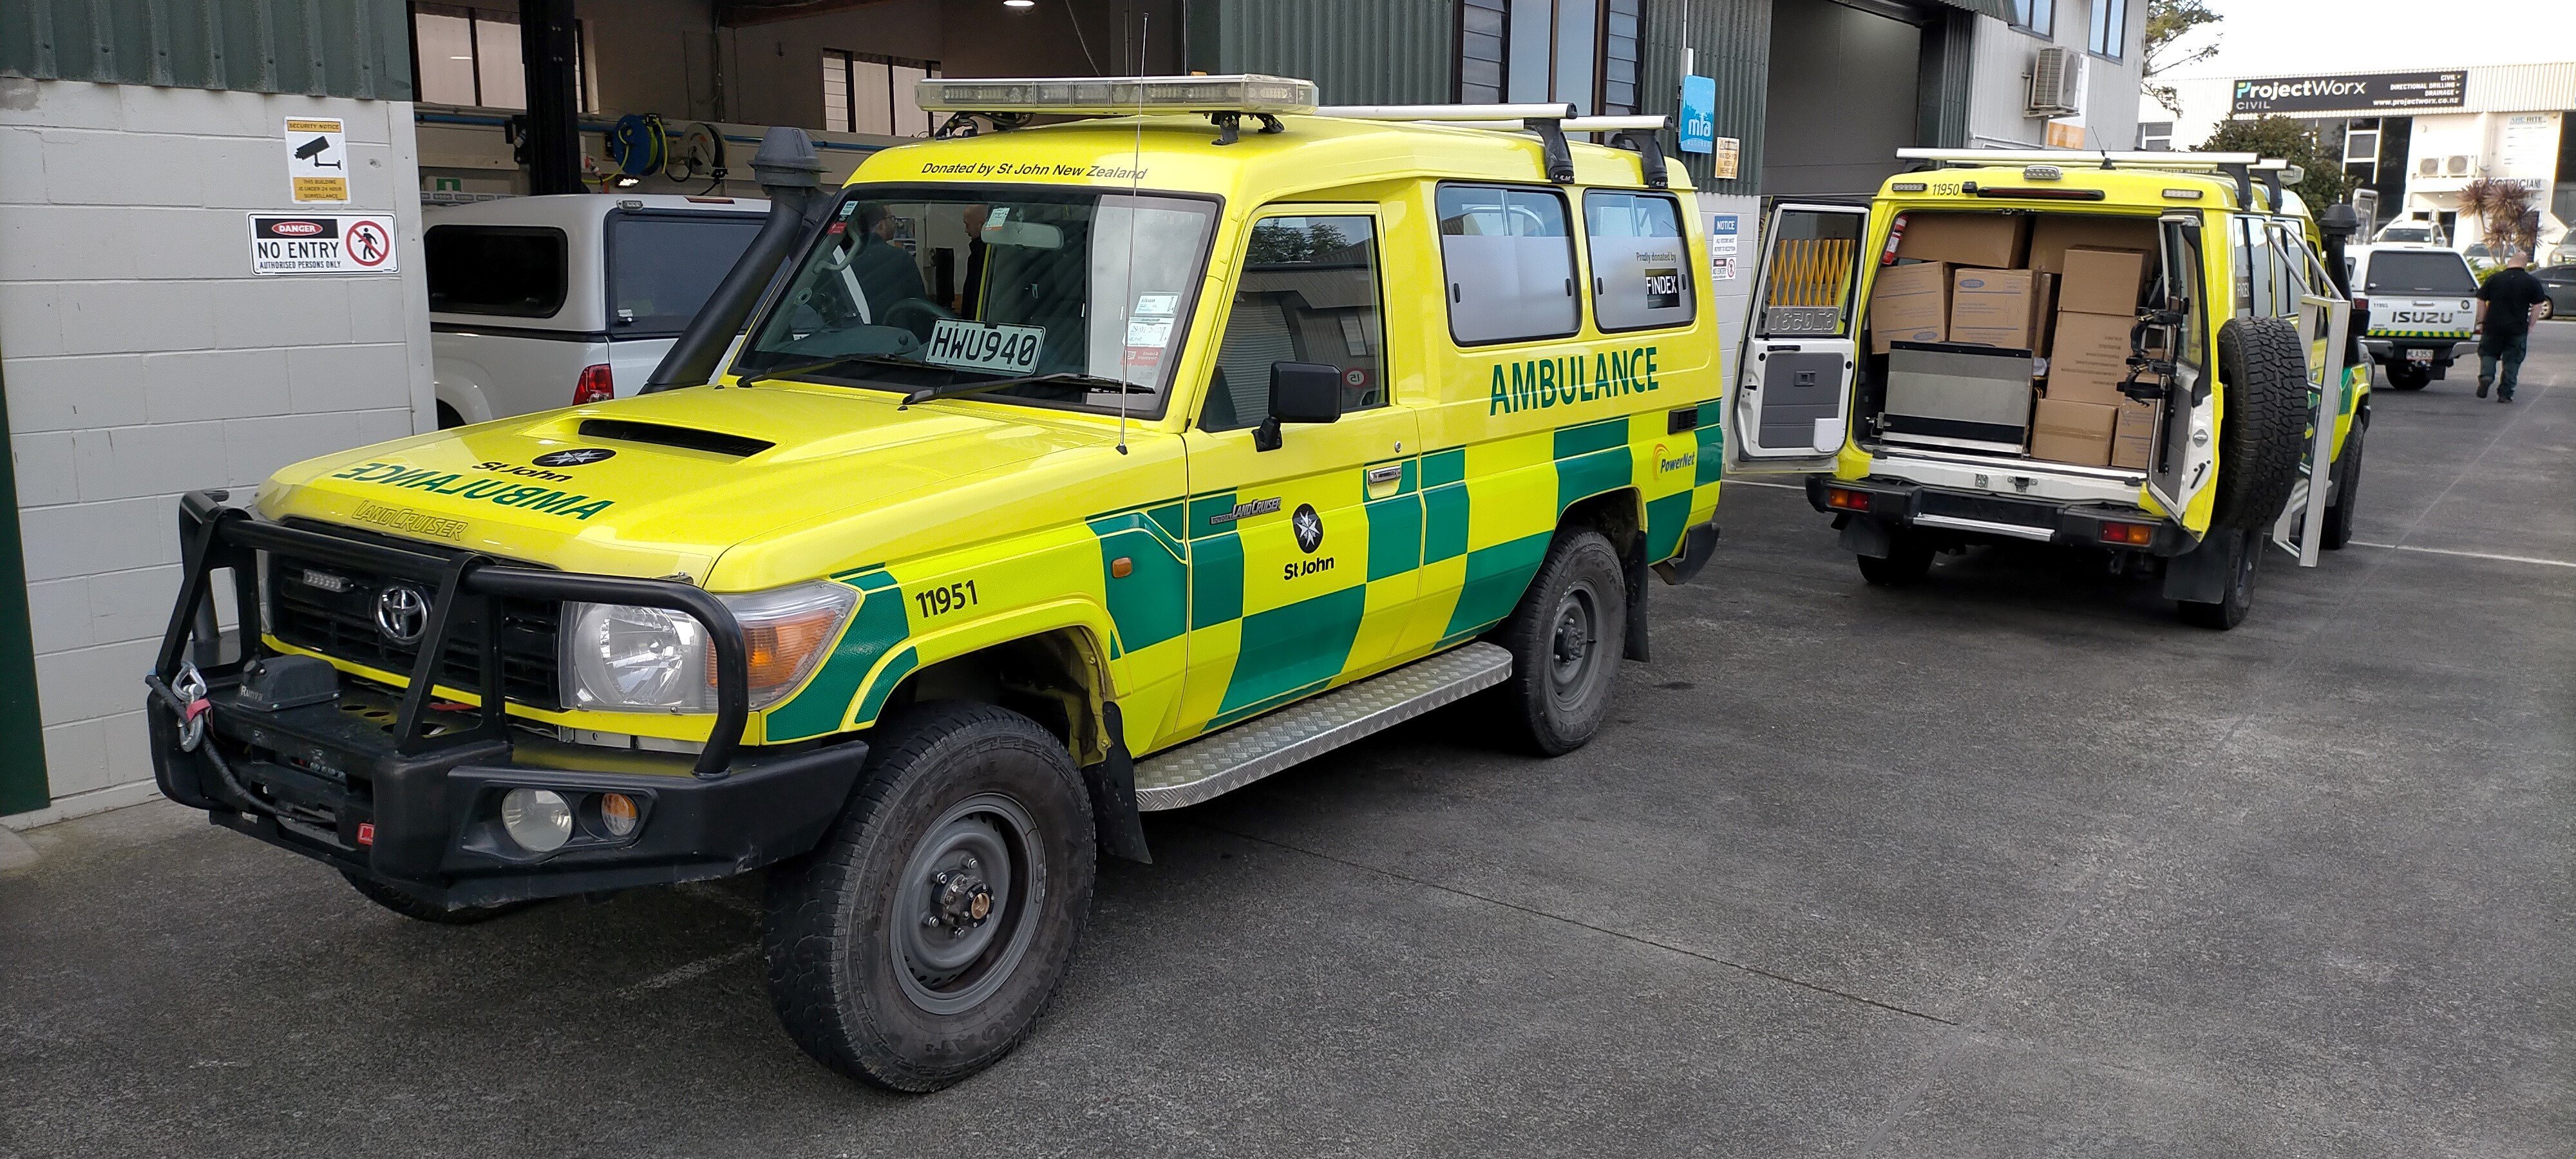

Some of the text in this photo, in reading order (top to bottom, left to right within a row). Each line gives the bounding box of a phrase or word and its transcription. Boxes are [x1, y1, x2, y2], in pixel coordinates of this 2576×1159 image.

[2237, 79, 2367, 100] ProjectWorx
[2236, 101, 2271, 110] CIVIL
[2372, 98, 2459, 106] www.projectworx.co.nz
[1688, 112, 1712, 137] mfa
[921, 162, 1149, 180] Donated by St John New Zealand
[1933, 183, 1960, 196] 11950
[1717, 220, 1735, 231] NOTICE
[258, 241, 339, 259] NO ENTRY
[1645, 276, 1678, 295] FINDEX
[2391, 311, 2453, 323] ISUZU
[931, 326, 1038, 366] HWU940
[1490, 346, 1659, 417] AMBULANCE
[471, 461, 574, 482] St John
[1660, 451, 1696, 474] PowerNet
[1212, 515, 1231, 524] TOYOTA
[1283, 556, 1334, 581] St John
[915, 579, 978, 619] 11951
